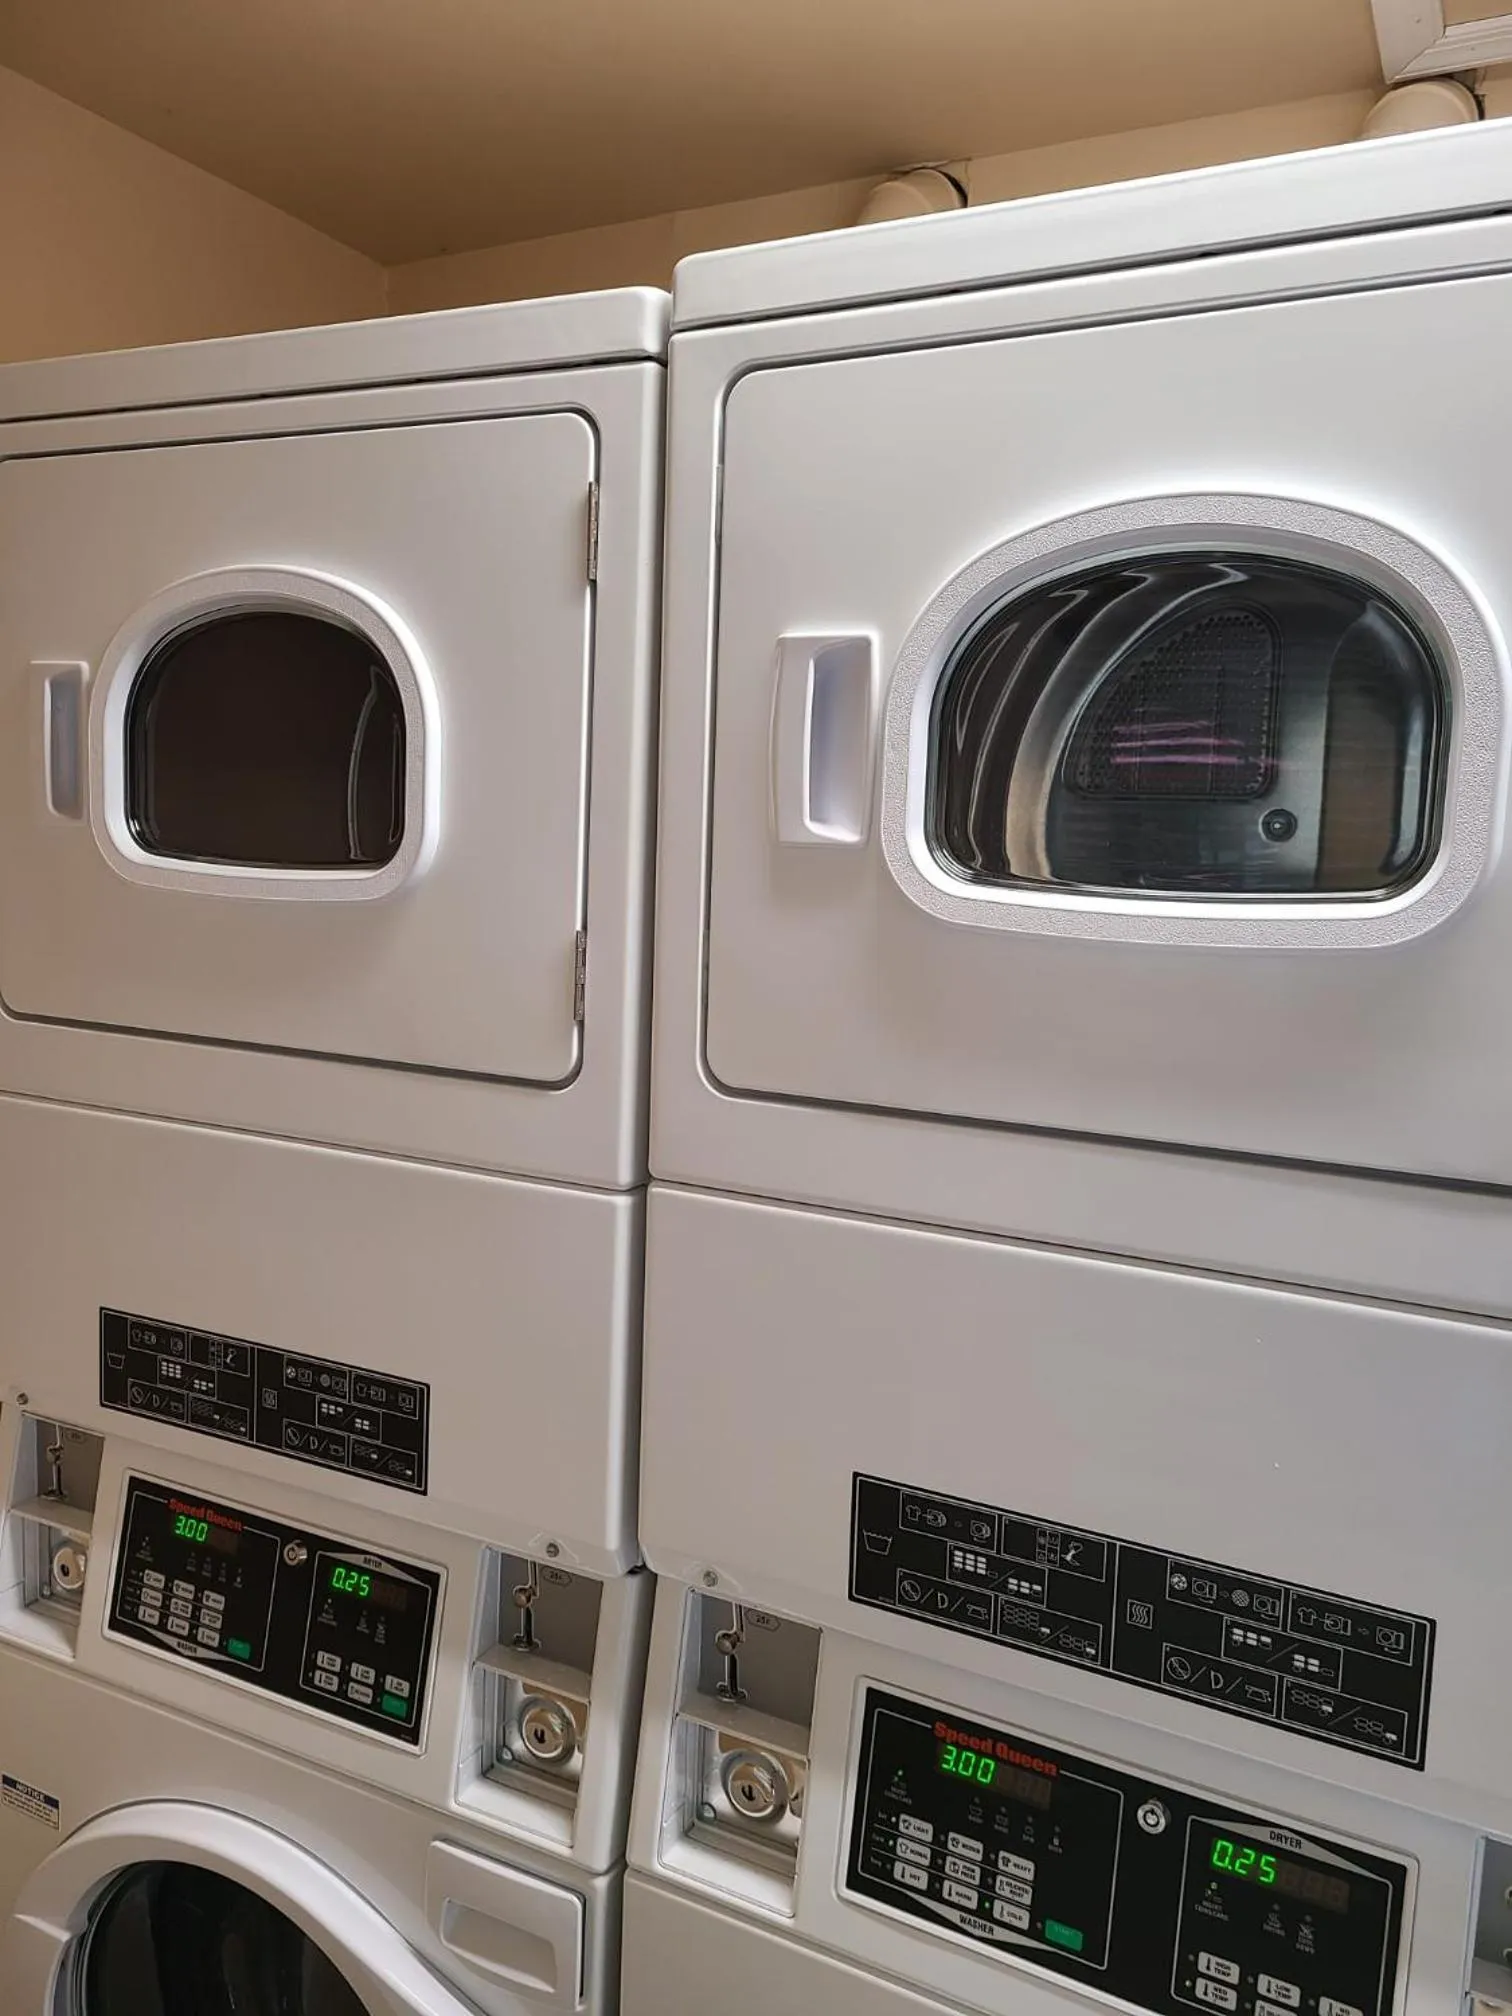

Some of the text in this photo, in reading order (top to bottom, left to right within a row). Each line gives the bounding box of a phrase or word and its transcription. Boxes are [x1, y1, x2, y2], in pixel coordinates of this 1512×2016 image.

[934, 1721, 1058, 1776] Speed Queen
[941, 1745, 995, 1784] 3.00
[1269, 1831, 1302, 1849] DRYER
[1211, 1839, 1277, 1884] 0.25
[959, 1913, 994, 1936] WASHER
